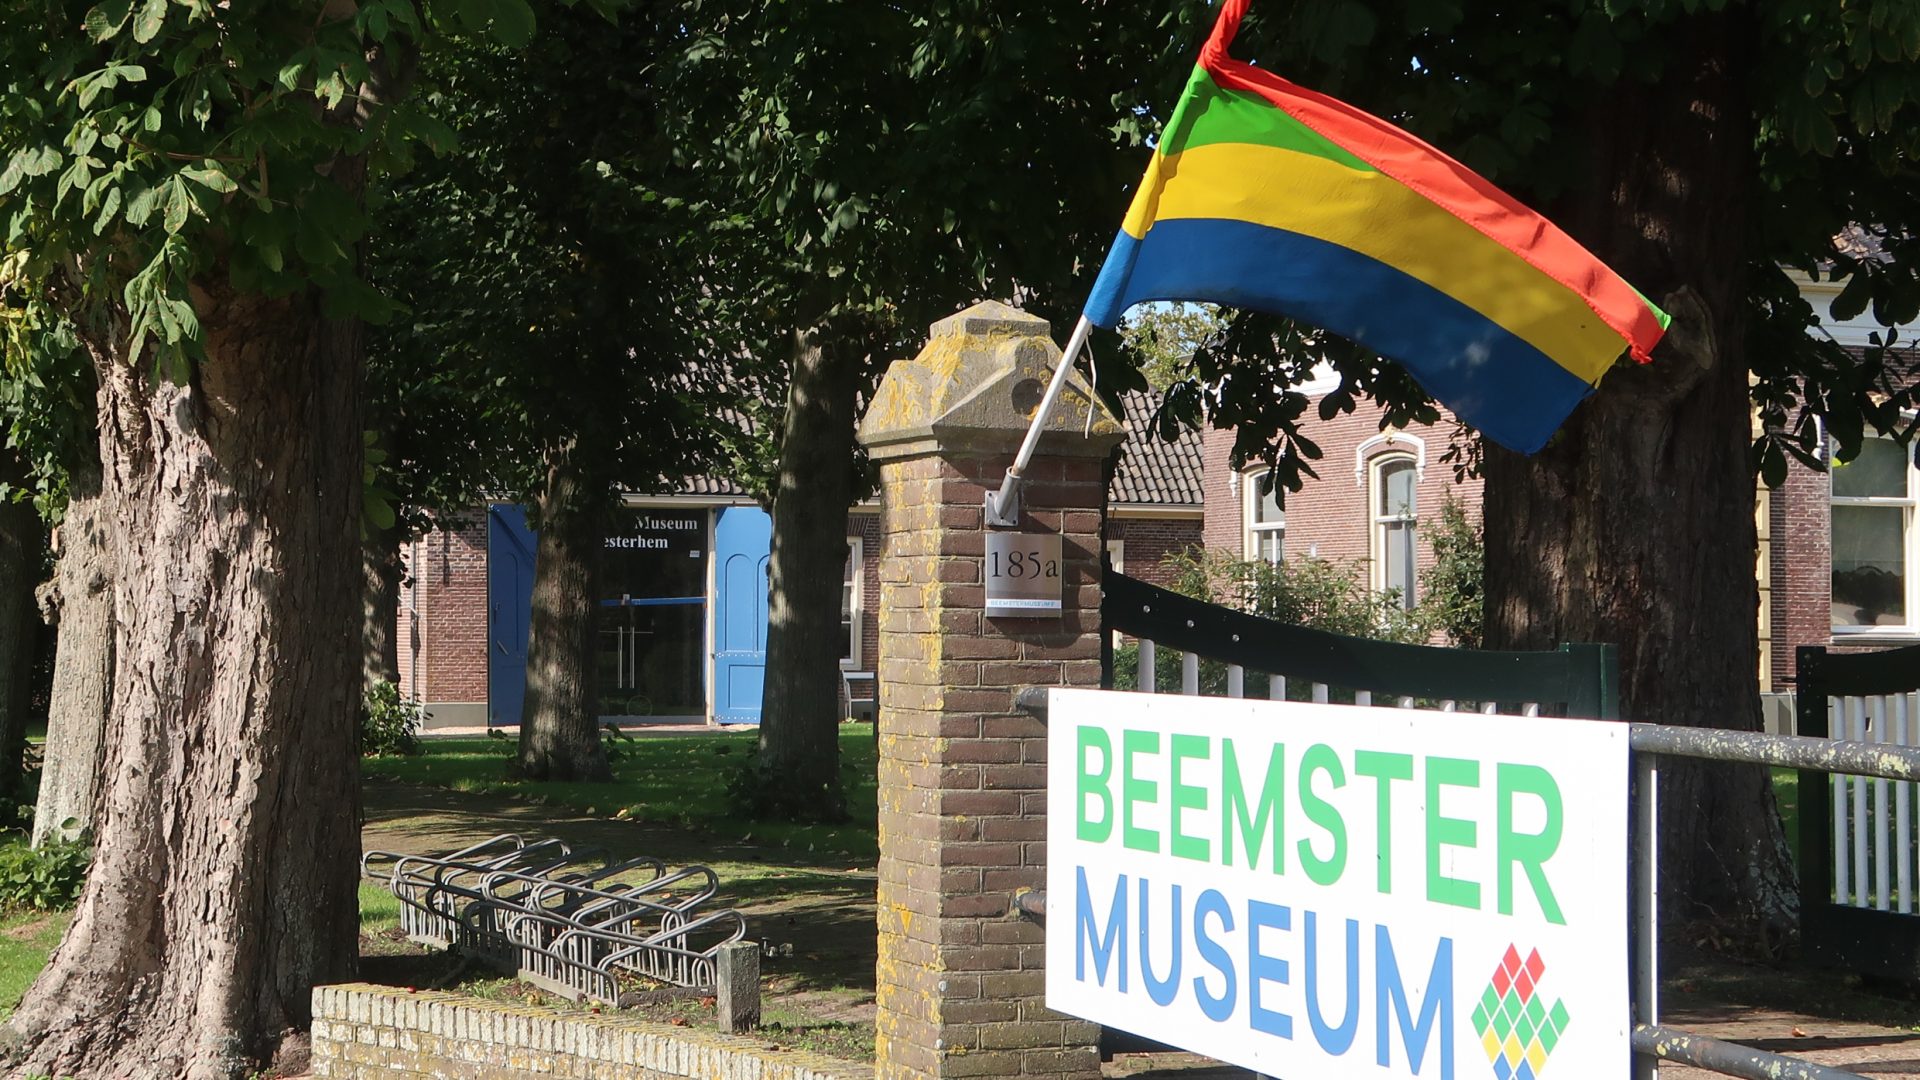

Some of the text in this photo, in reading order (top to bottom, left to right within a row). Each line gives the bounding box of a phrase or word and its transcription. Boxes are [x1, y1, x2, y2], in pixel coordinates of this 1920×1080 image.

[635, 515, 698, 530] Museum
[604, 534, 668, 549] esterhem
[991, 550, 1058, 579] 185a
[1076, 725, 1567, 926] BEEMSTER
[1075, 865, 1454, 1080] MUSEUM
